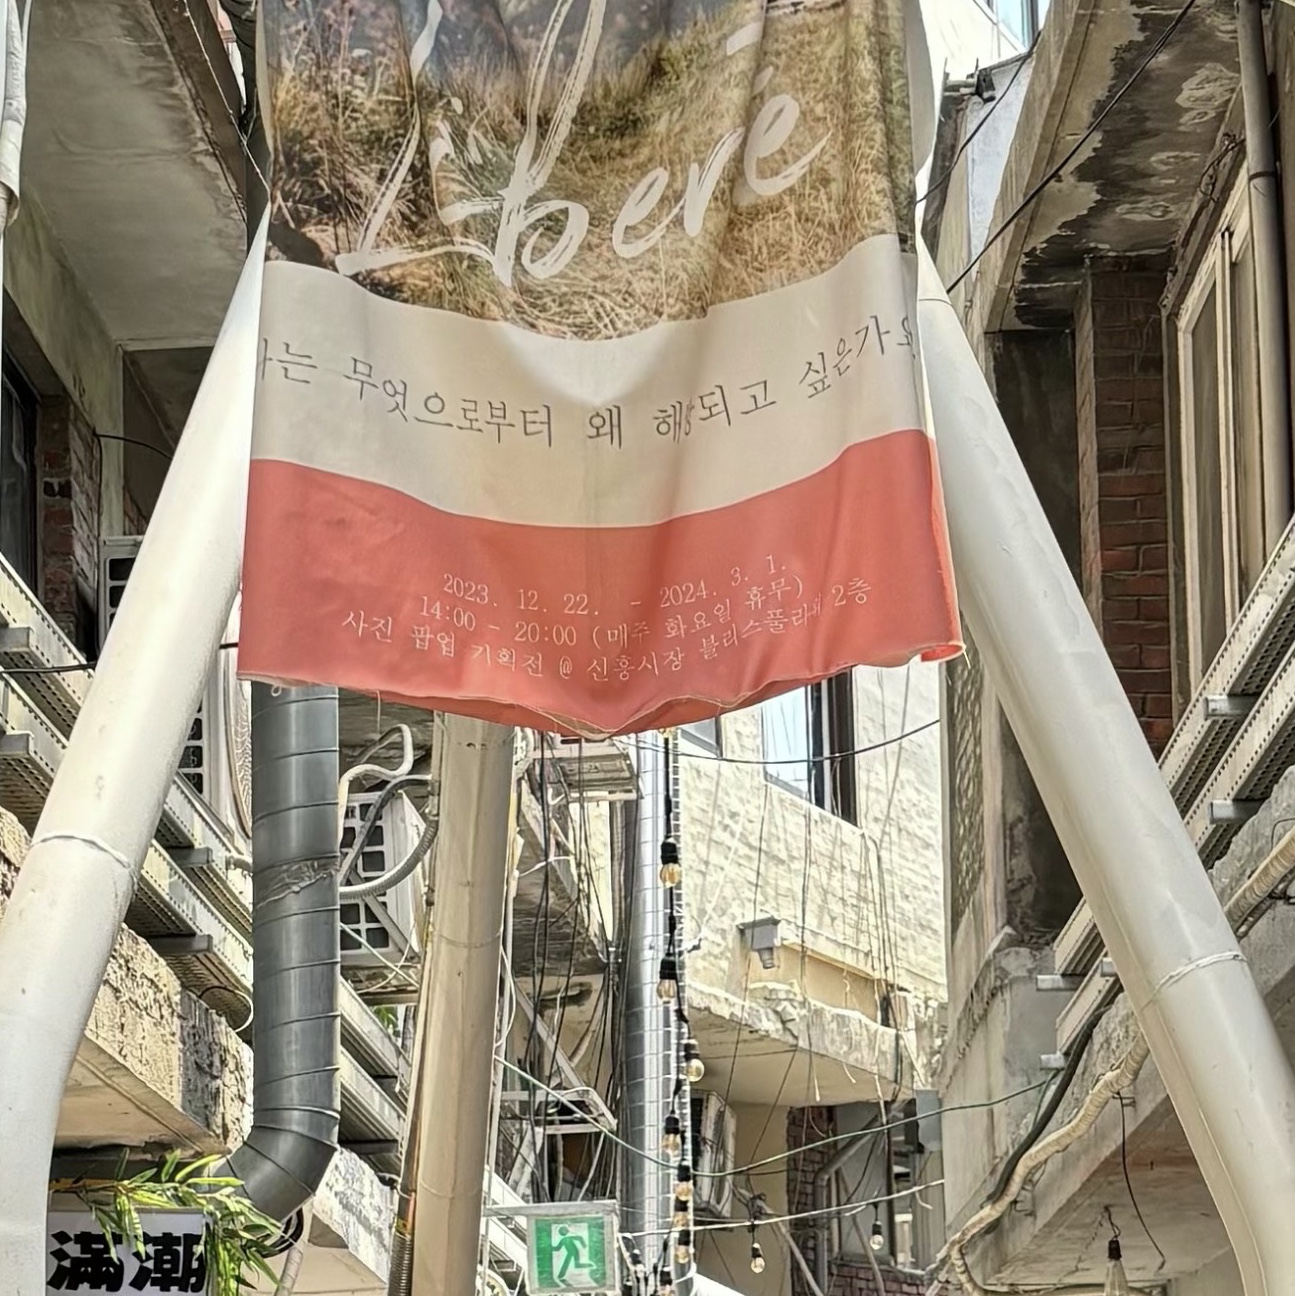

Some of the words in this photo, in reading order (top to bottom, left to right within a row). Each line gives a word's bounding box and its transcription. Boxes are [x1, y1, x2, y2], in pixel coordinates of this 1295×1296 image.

[344, 355, 553, 448] 무엇으로부터
[587, 405, 624, 450] 왜
[341, 609, 394, 645] 사진
[411, 623, 457, 660] 팝업
[471, 643, 545, 678] 기획전
[587, 648, 685, 684] 신흥시장
[831, 576, 873, 608] 2층
[420, 595, 477, 632] 14:00
[514, 620, 579, 647] 20:00
[592, 622, 651, 652] (매주
[666, 598, 733, 640] 화요일
[745, 574, 805, 611] 휴무)
[443, 573, 498, 606] 2023.
[517, 589, 547, 613] 12.
[563, 592, 600, 616] 22.
[659, 577, 718, 610] 2024.
